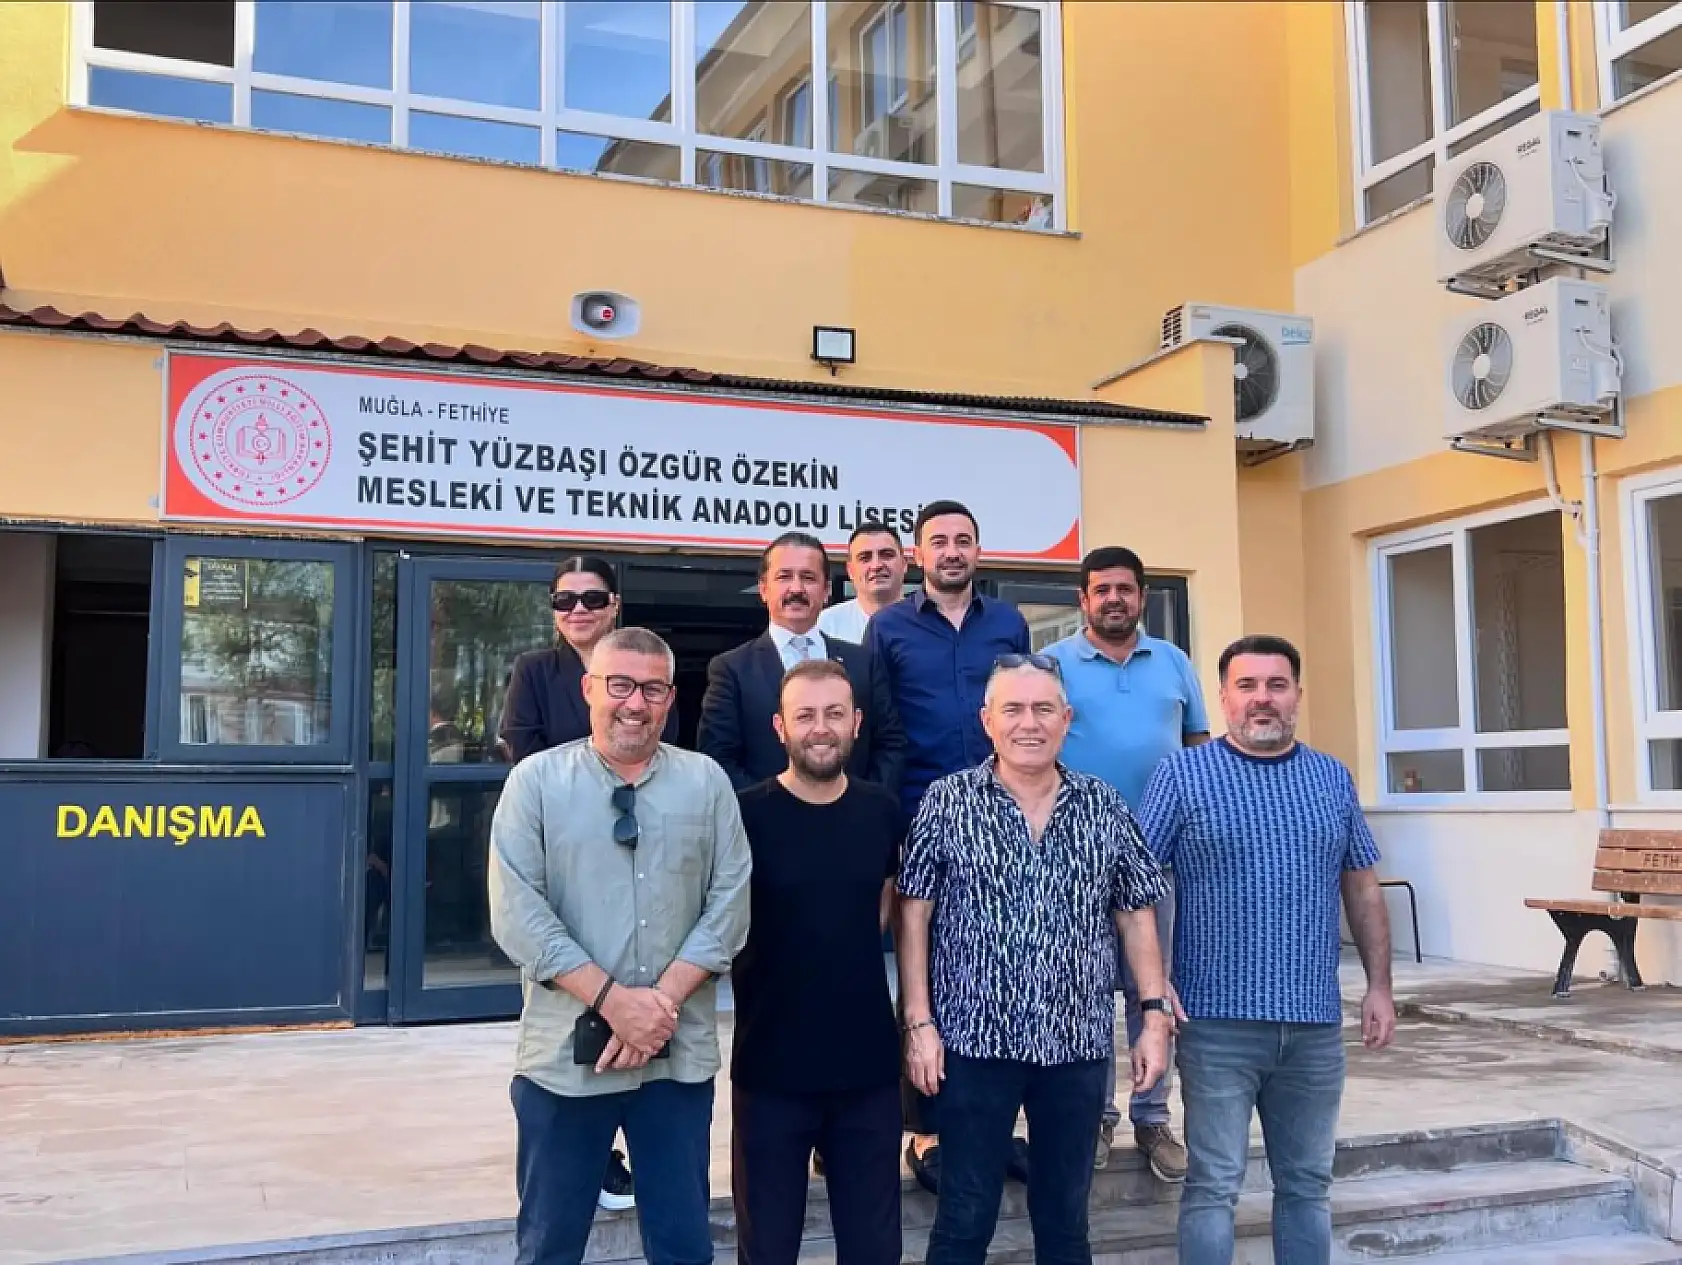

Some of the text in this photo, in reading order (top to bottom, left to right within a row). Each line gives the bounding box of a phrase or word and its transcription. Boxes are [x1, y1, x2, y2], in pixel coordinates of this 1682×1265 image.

[1517, 137, 1541, 153] REGAL
[359, 394, 423, 418] MUĞLA
[438, 401, 510, 425] FETHİYE
[357, 429, 838, 490] ŞEHİT YÜZBAŞI ÖZGÜR ÖZEKİN
[357, 475, 503, 512] MESLEKİ
[515, 485, 555, 514] VE
[566, 487, 682, 522] TEKNİK
[692, 495, 829, 530] ANADOLU
[56, 804, 267, 846] DANIŞMA
